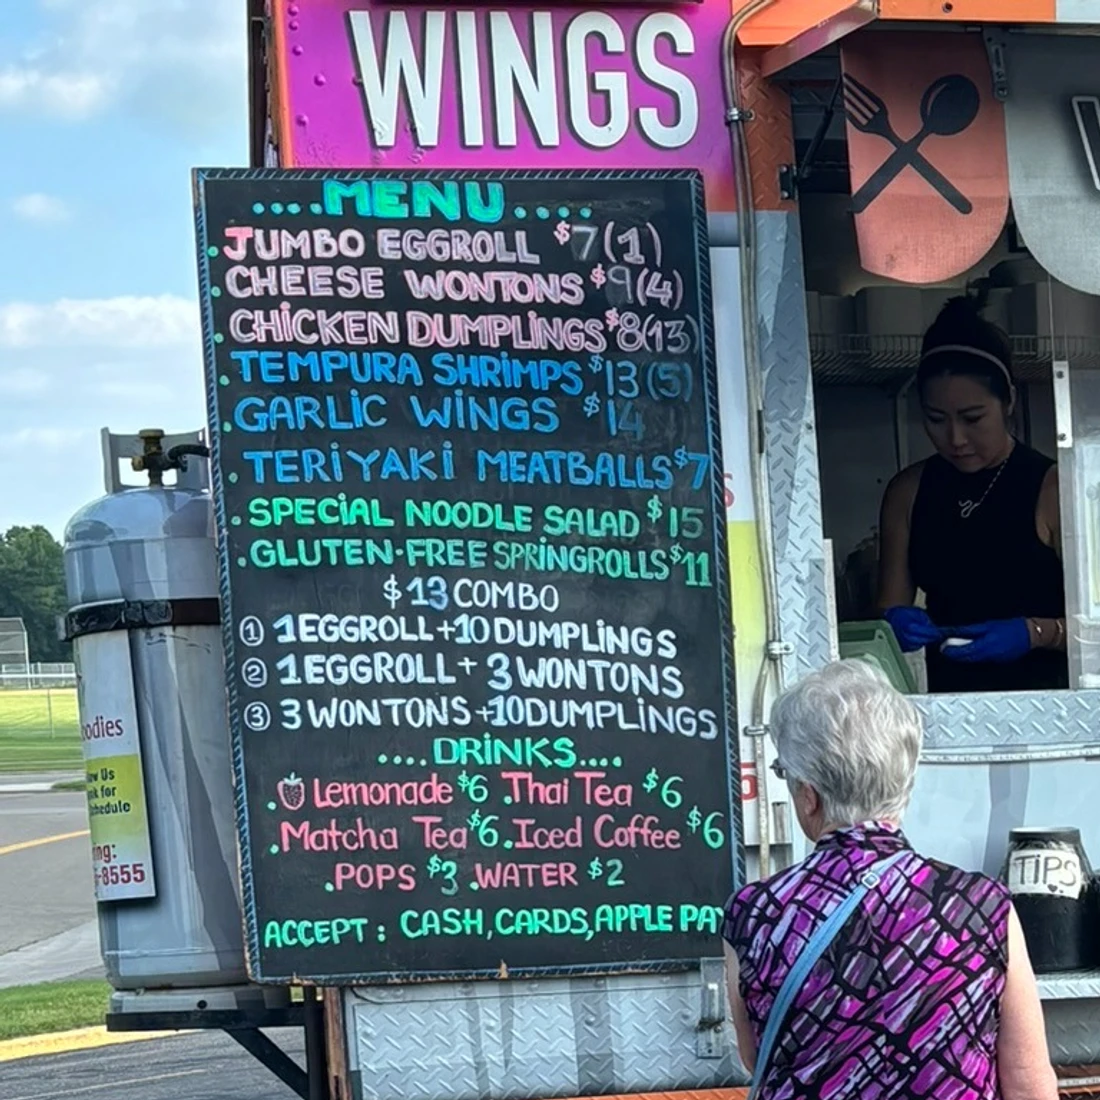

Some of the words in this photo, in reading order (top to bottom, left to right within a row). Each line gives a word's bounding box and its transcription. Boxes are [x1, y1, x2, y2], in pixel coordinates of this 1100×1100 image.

[347, 10, 698, 149] WINGS
[224, 227, 365, 261] JUMBO
[378, 229, 540, 264] EGGROLL
[224, 264, 385, 300] CHEESE
[405, 268, 585, 305] WONTONS
[230, 350, 424, 386] TEMPURA
[477, 448, 673, 489] MEATBALLS
[405, 499, 533, 534] NOODLE
[542, 507, 640, 539] SALAD
[383, 575, 447, 613] $13
[452, 580, 559, 613] COMBO
[516, 657, 684, 698] WONTONS
[308, 697, 472, 729] WONTONS
[313, 770, 454, 808] Lemonade
[457, 769, 489, 804] $6
[501, 770, 570, 807] Thai
[573, 772, 633, 807] Tea
[643, 767, 684, 808] $6
[281, 817, 398, 852] Matcha
[413, 816, 468, 850] Tea
[467, 807, 499, 849] $6
[512, 815, 583, 849] Iced
[593, 813, 681, 850] Coffee
[686, 805, 726, 849] $6
[335, 863, 417, 892] POPS
[426, 854, 459, 896] $3
[475, 861, 579, 889] WATER
[587, 859, 625, 887] $2
[595, 904, 672, 933] APPLE
[680, 904, 725, 934] PA
